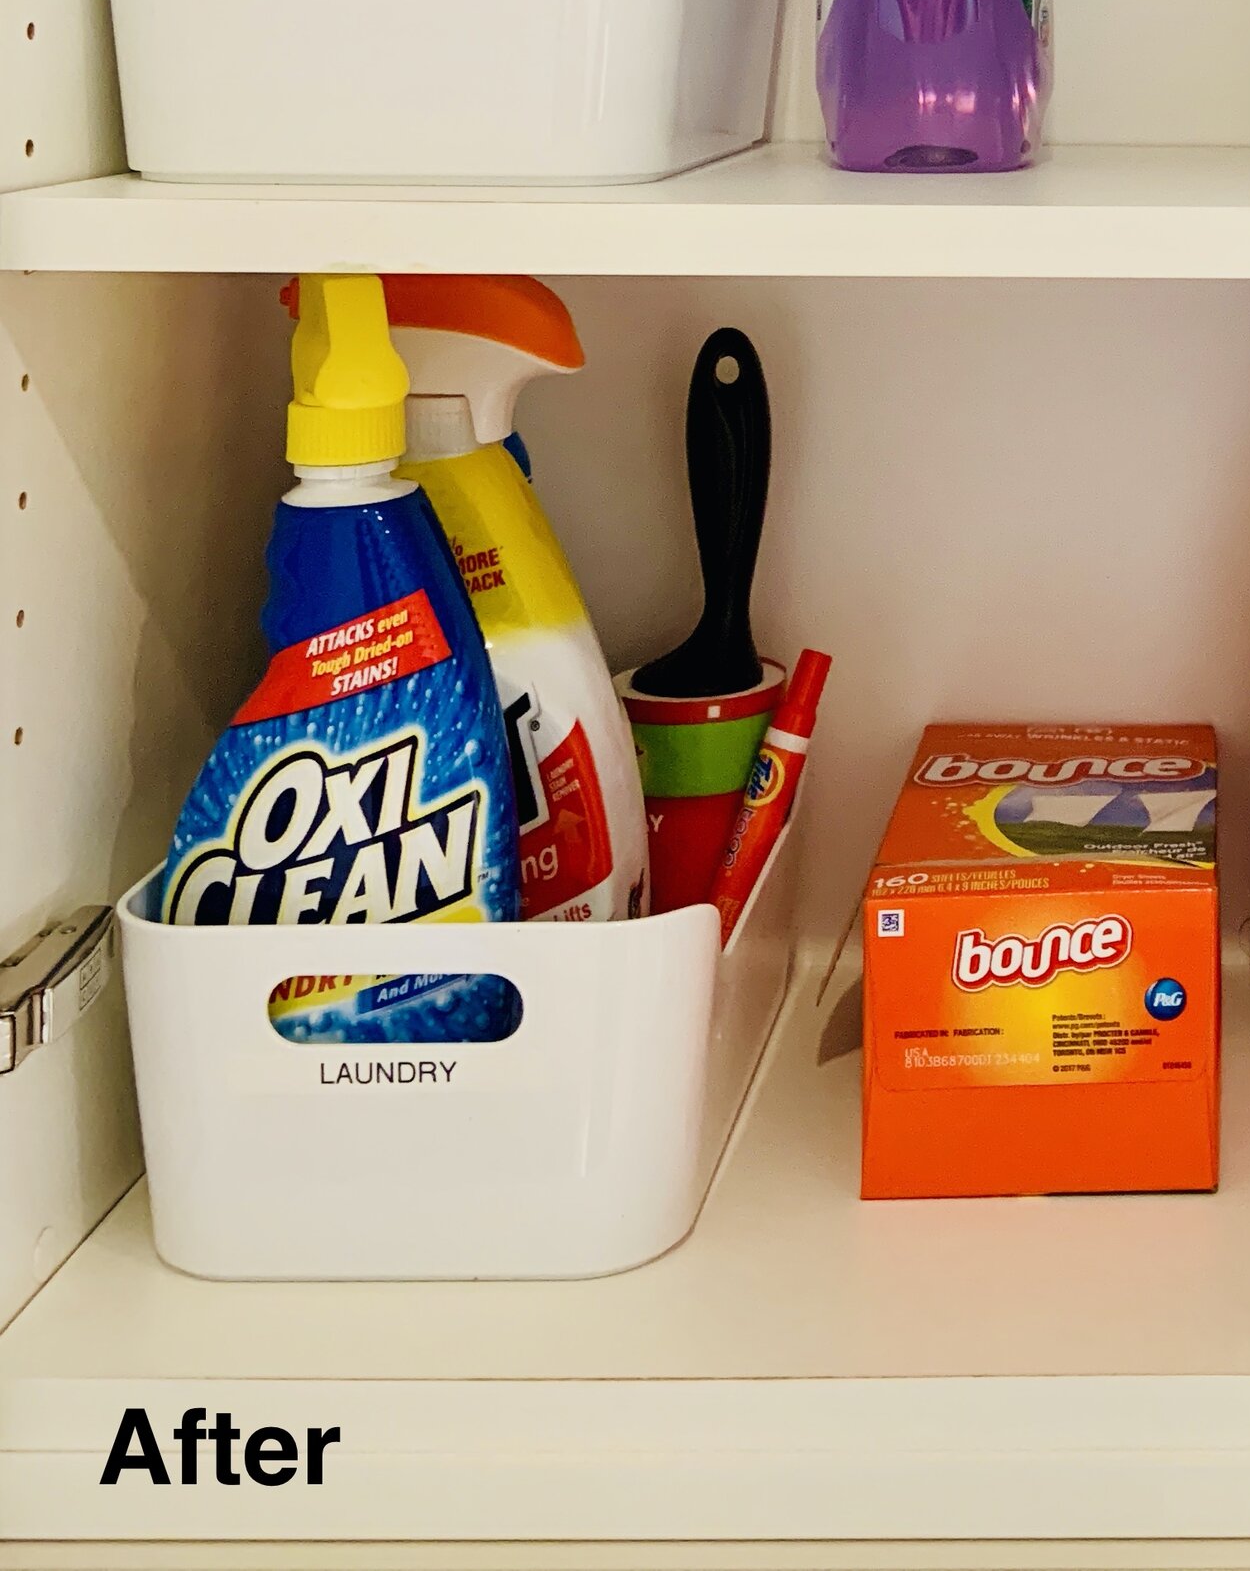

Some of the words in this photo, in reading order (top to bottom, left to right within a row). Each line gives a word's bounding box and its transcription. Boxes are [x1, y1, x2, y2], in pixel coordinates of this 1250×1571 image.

[305, 619, 375, 658] ATTACKS
[378, 609, 409, 634] even
[311, 649, 350, 678] Tough
[353, 629, 414, 663] Dried-on
[330, 657, 399, 697] STAINS!
[923, 755, 1192, 783] bounce
[236, 740, 416, 871] OXI
[874, 872, 930, 889] 160
[970, 878, 1050, 891] INCHES/POUCES
[553, 903, 592, 922] ifts
[955, 916, 1126, 987] bounce
[377, 981, 409, 1003] And
[1153, 991, 1182, 1007] P&G
[894, 1030, 939, 1040] FABRICATED
[905, 1047, 929, 1058] USA
[320, 1061, 457, 1085] LAUNDRY
